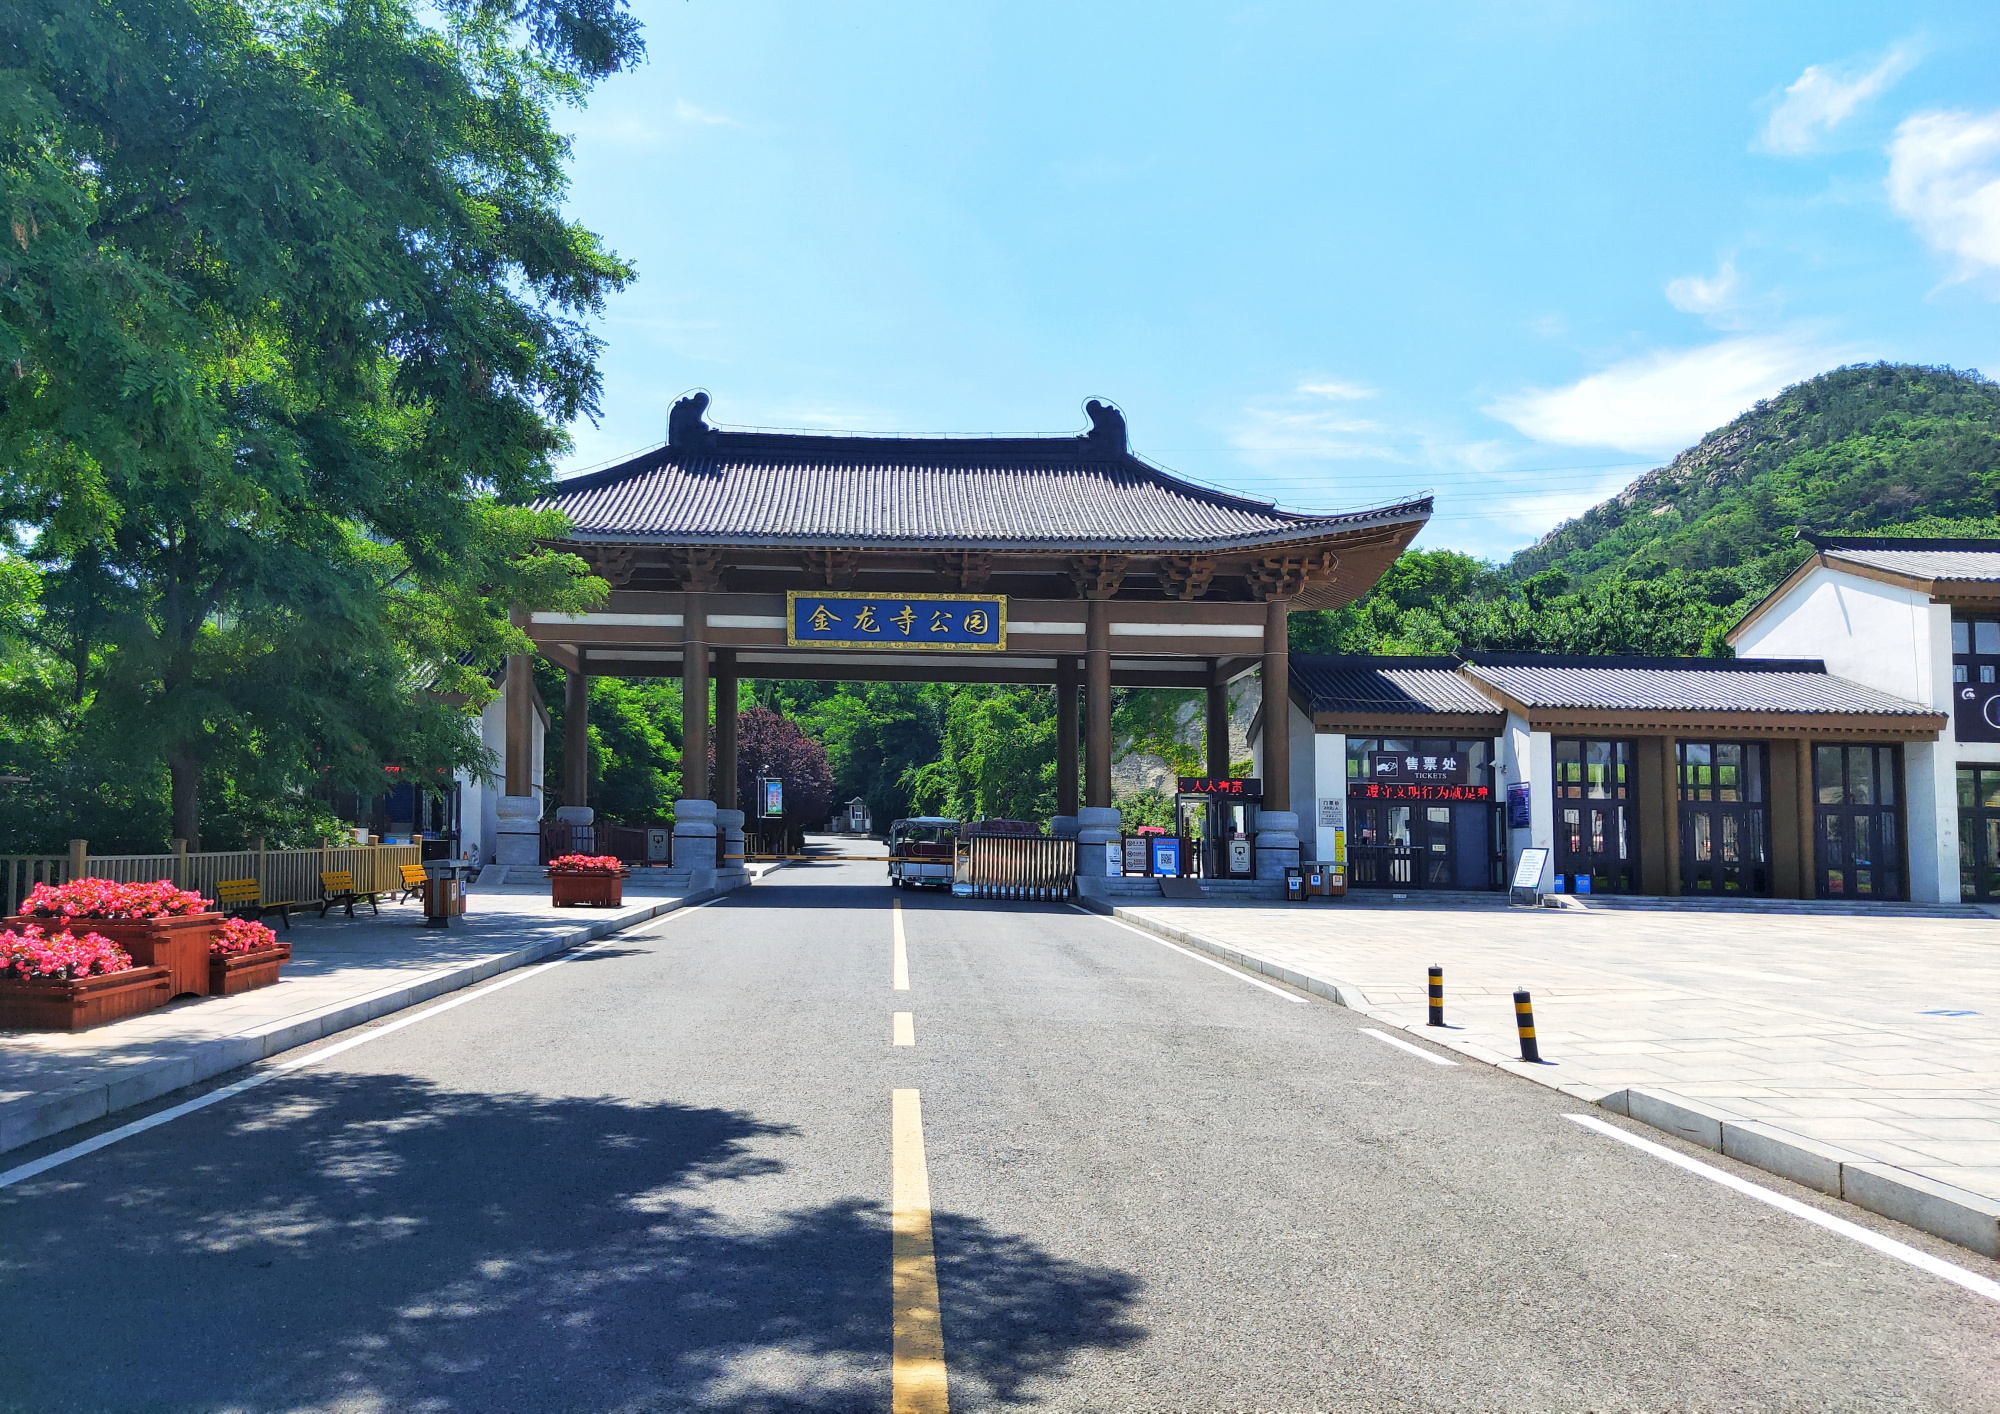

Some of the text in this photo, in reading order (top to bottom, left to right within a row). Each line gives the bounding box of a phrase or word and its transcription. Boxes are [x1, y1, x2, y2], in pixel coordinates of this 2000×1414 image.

[806, 604, 989, 636] 金龙寺公园
[1405, 756, 1457, 771] 售票处
[1191, 779, 1244, 793] 人人有责
